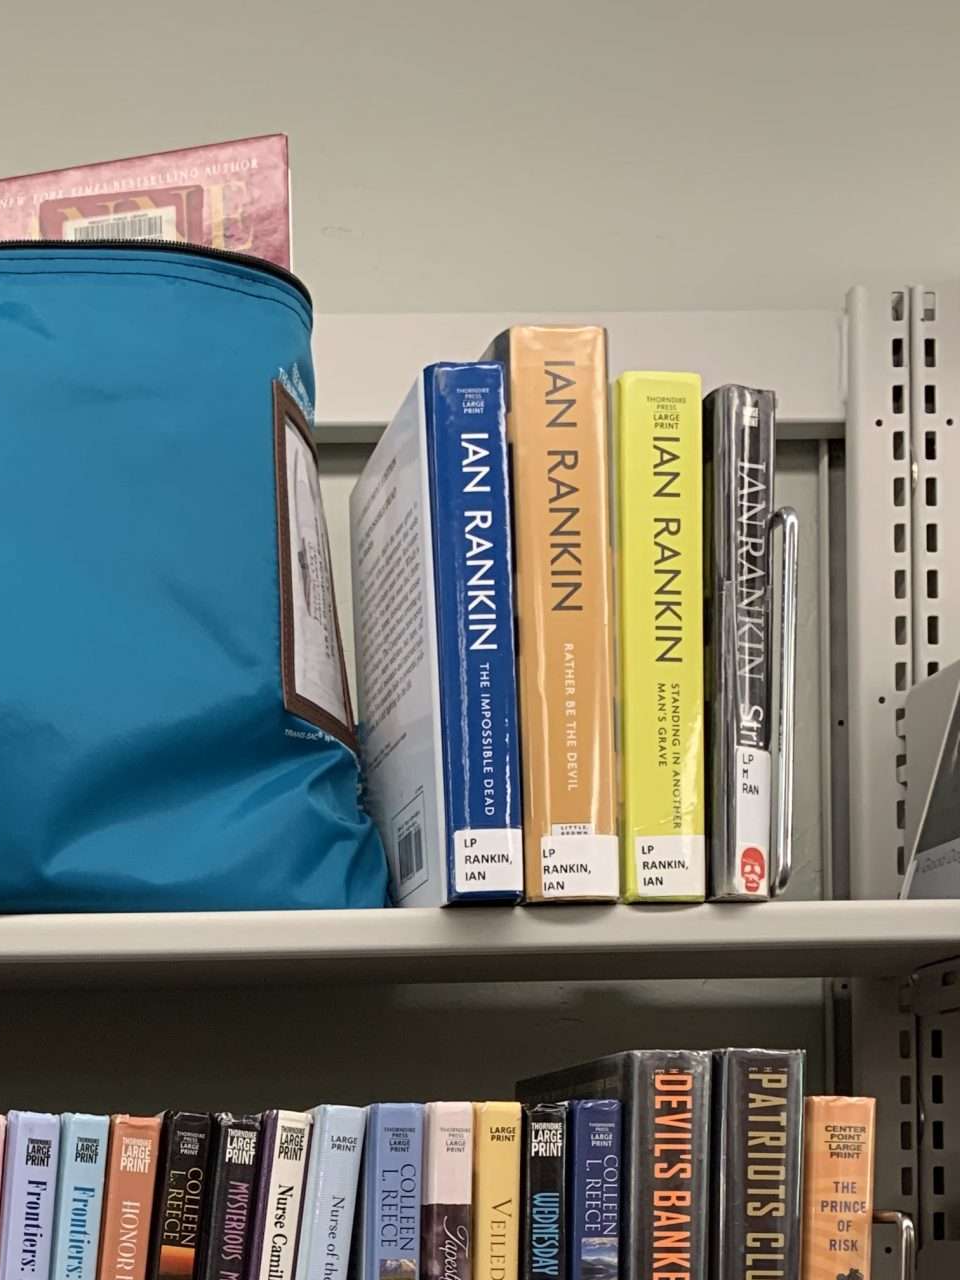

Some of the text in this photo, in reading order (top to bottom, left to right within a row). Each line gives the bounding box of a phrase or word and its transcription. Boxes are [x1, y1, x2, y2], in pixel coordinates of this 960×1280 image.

[113, 167, 198, 192] BESTSELLING
[205, 158, 259, 177] AUTHOR
[544, 360, 583, 612] IAN RANKIN
[460, 432, 497, 650] IAN RANKIN
[653, 435, 683, 663] IAN RANKIN
[481, 663, 494, 816] THE IMPOSSIBLE DEAD
[564, 644, 578, 791] RATHER BE THE DEVIL
[657, 683, 667, 767] MAN'S GRAVE
[671, 682, 682, 829] STANDING IN ANOTHER
[465, 854, 513, 865] RANKIN,
[465, 872, 486, 881] IAN
[653, 1075, 691, 1180] DEVIL'S
[747, 1073, 788, 1217] PATRIOTS
[274, 1184, 294, 1229] Nurse
[820, 1201, 866, 1214] PRINCE
[833, 1182, 856, 1194] THE
[837, 1220, 852, 1233] OF
[531, 1192, 559, 1278] WEDNESDAY
[828, 1238, 858, 1253] RISK
